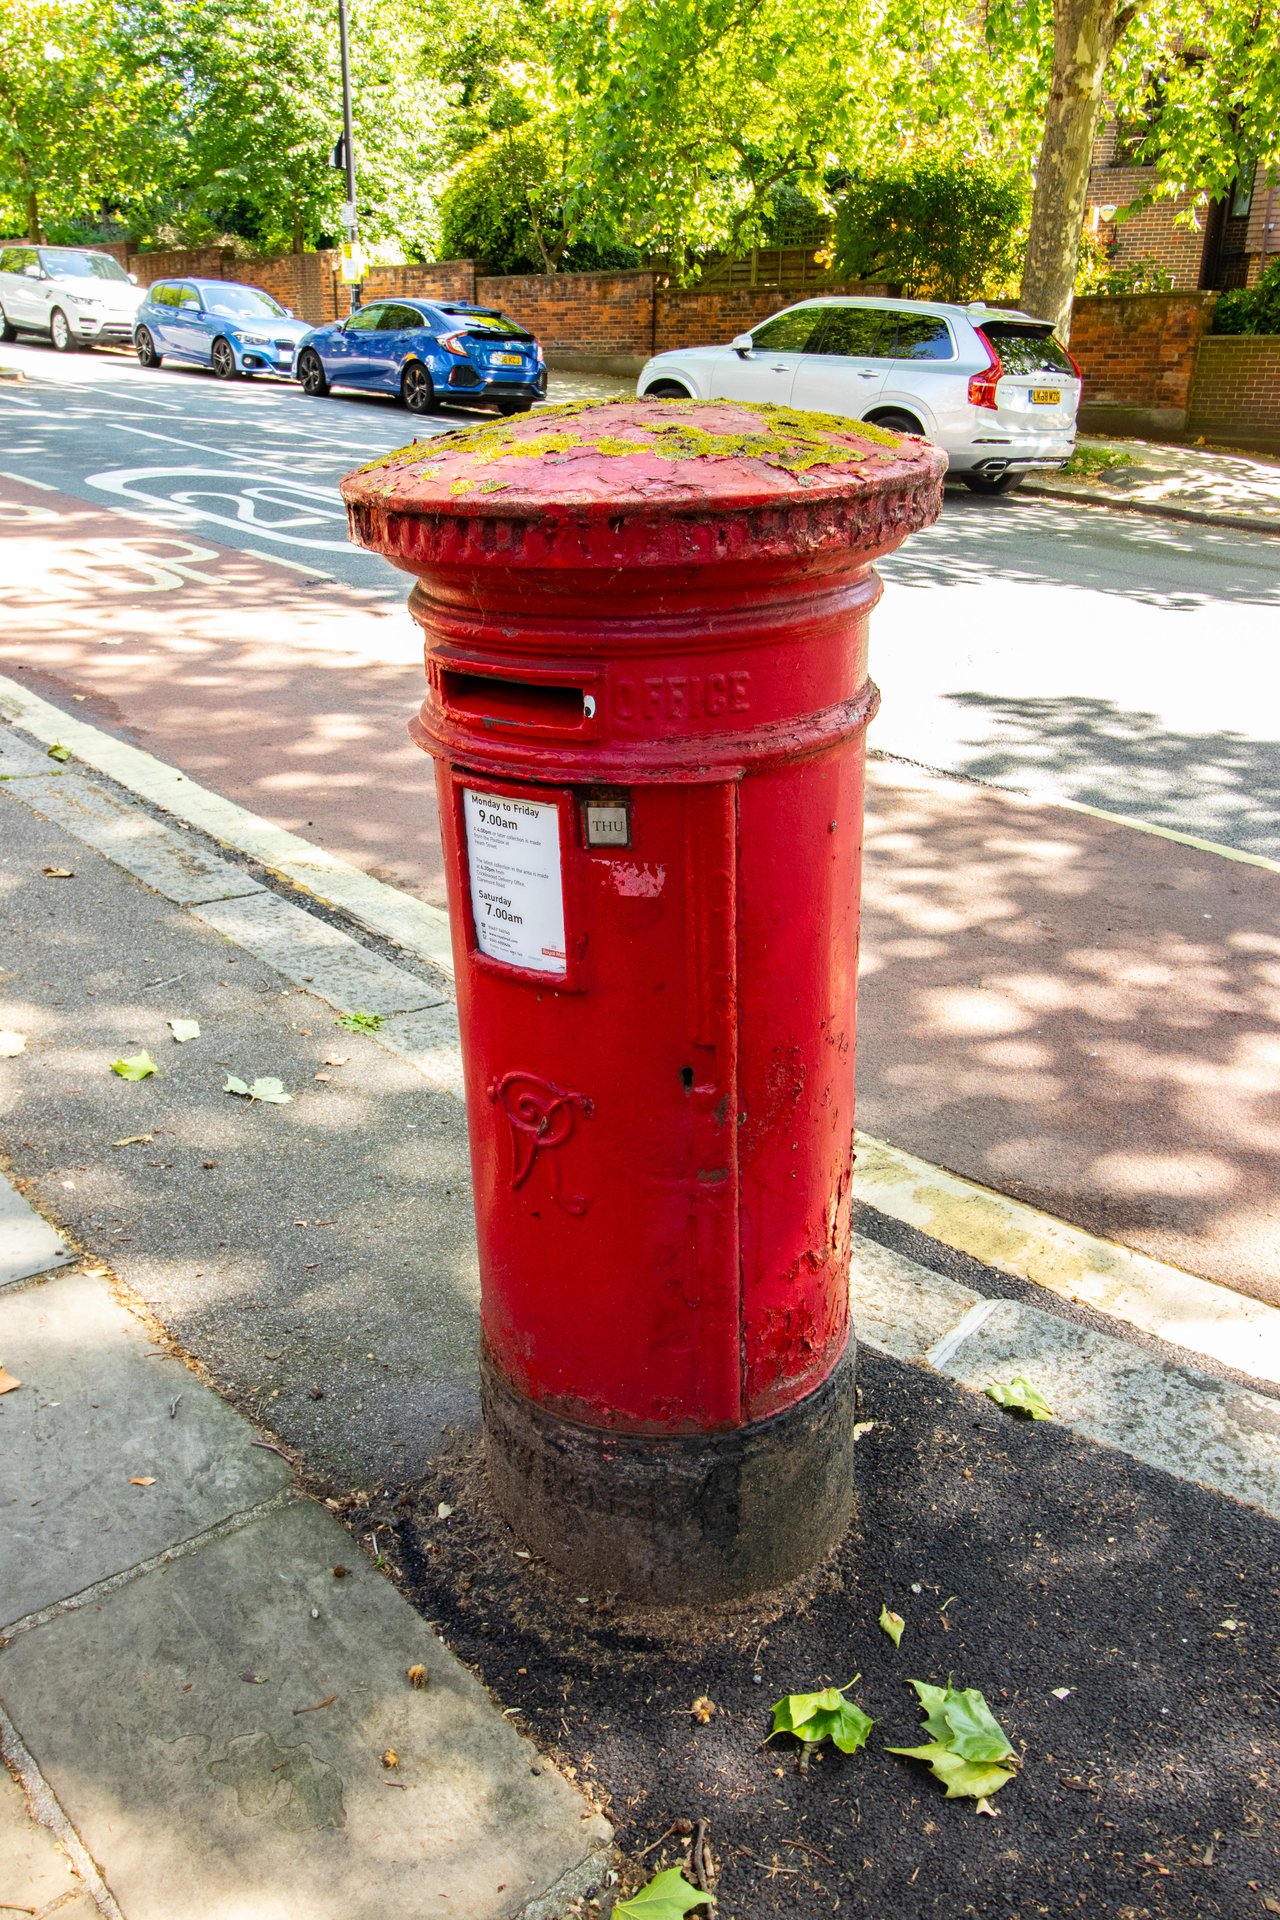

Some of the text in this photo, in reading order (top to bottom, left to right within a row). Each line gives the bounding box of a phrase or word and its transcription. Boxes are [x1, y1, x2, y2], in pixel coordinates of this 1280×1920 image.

[613, 670, 750, 720] OFFICE
[471, 795, 540, 818] Monday to Friday
[478, 809, 518, 830] 9.00am
[592, 820, 624, 832] THU
[478, 889, 512, 907] Saturday
[485, 903, 523, 925] 7.00am
